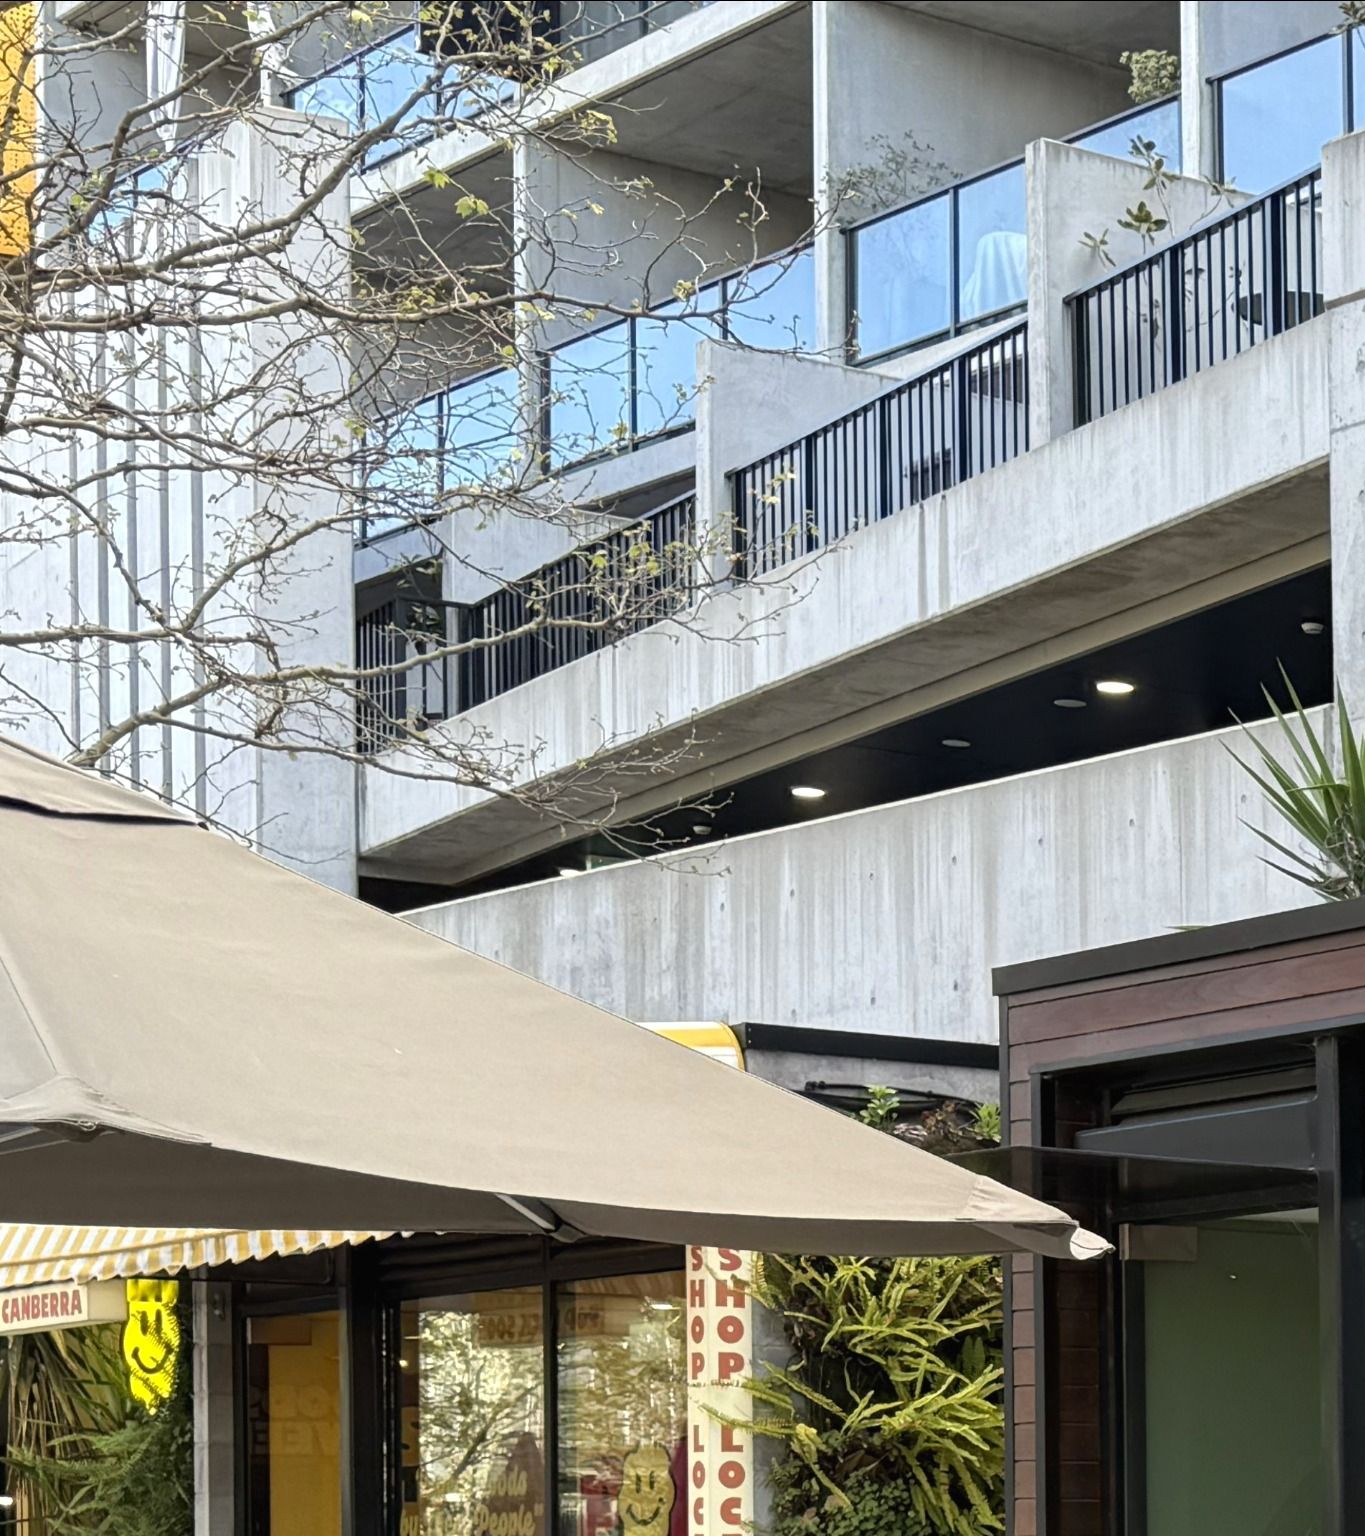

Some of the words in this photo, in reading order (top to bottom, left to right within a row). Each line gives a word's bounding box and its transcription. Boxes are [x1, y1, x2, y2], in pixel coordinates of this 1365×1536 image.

[1, 1289, 83, 1324] CANBERRA
[690, 1245, 706, 1381] SHOP
[715, 1247, 750, 1381] SHOP
